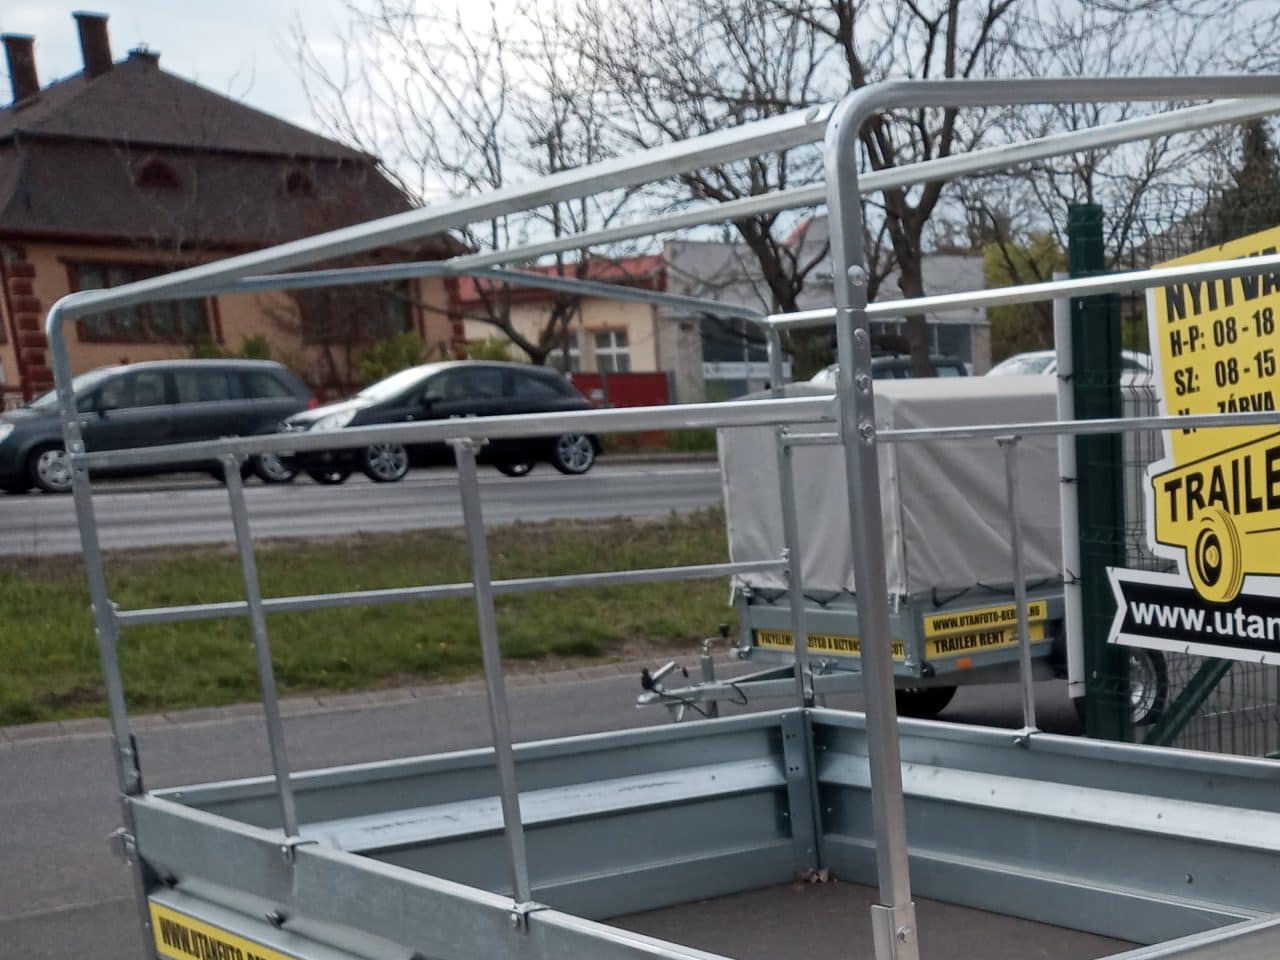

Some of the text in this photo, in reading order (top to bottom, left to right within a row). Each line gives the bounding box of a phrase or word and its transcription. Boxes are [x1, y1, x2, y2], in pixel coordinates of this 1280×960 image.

[1170, 325, 1206, 358] H-P:
[1212, 316, 1238, 347] 08
[1252, 307, 1275, 337] 18
[1174, 367, 1200, 397] SZ:
[1215, 357, 1240, 388] 08
[1254, 348, 1276, 379] 15
[933, 605, 1041, 632] WWW.UTANFUTO-BER.HU
[934, 630, 1005, 654] TRAILER RENT
